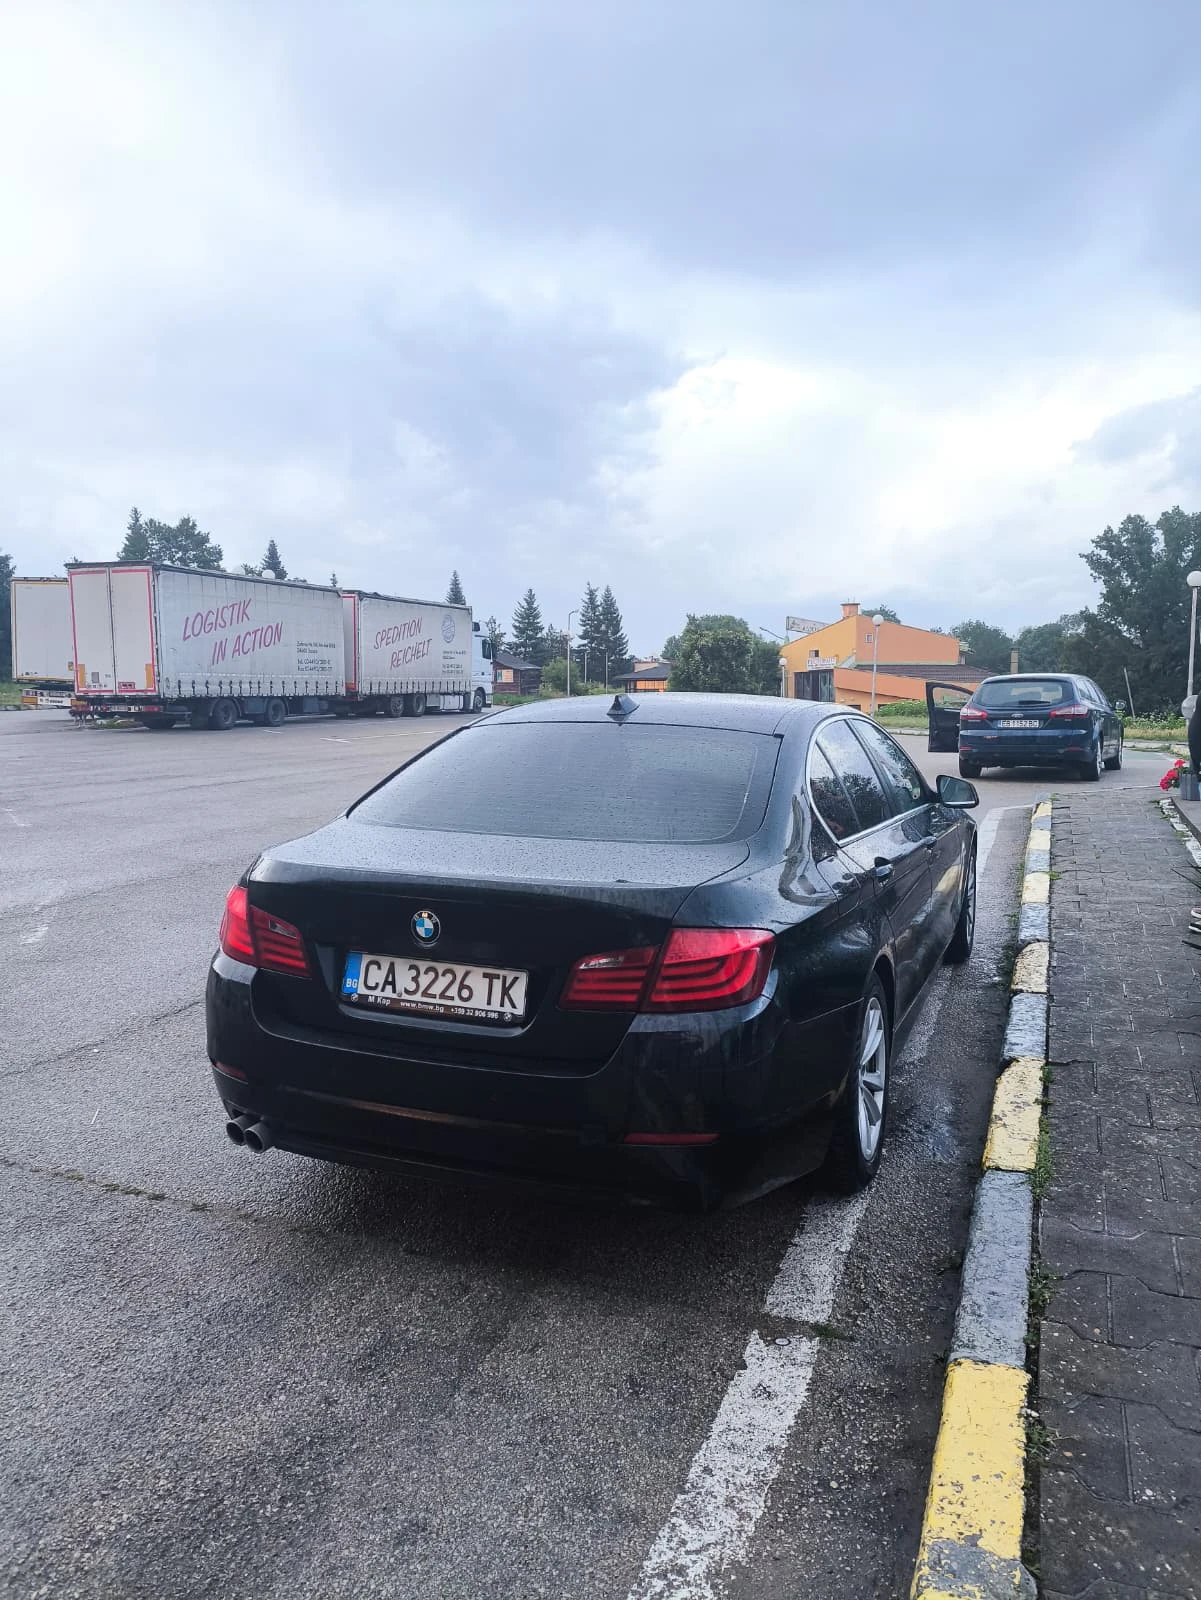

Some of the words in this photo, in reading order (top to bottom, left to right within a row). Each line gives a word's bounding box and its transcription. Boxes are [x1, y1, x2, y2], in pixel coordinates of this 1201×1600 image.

[182, 598, 252, 642] LOGISTIK
[373, 616, 423, 650] SPEDITION
[212, 637, 228, 666] IN
[231, 621, 283, 659] ACTION
[390, 638, 433, 671] REICHELT
[345, 978, 358, 989] BG
[403, 964, 474, 1003] 3226
[482, 972, 520, 1010] TK
[400, 1001, 445, 1013] www.bmw.bg
